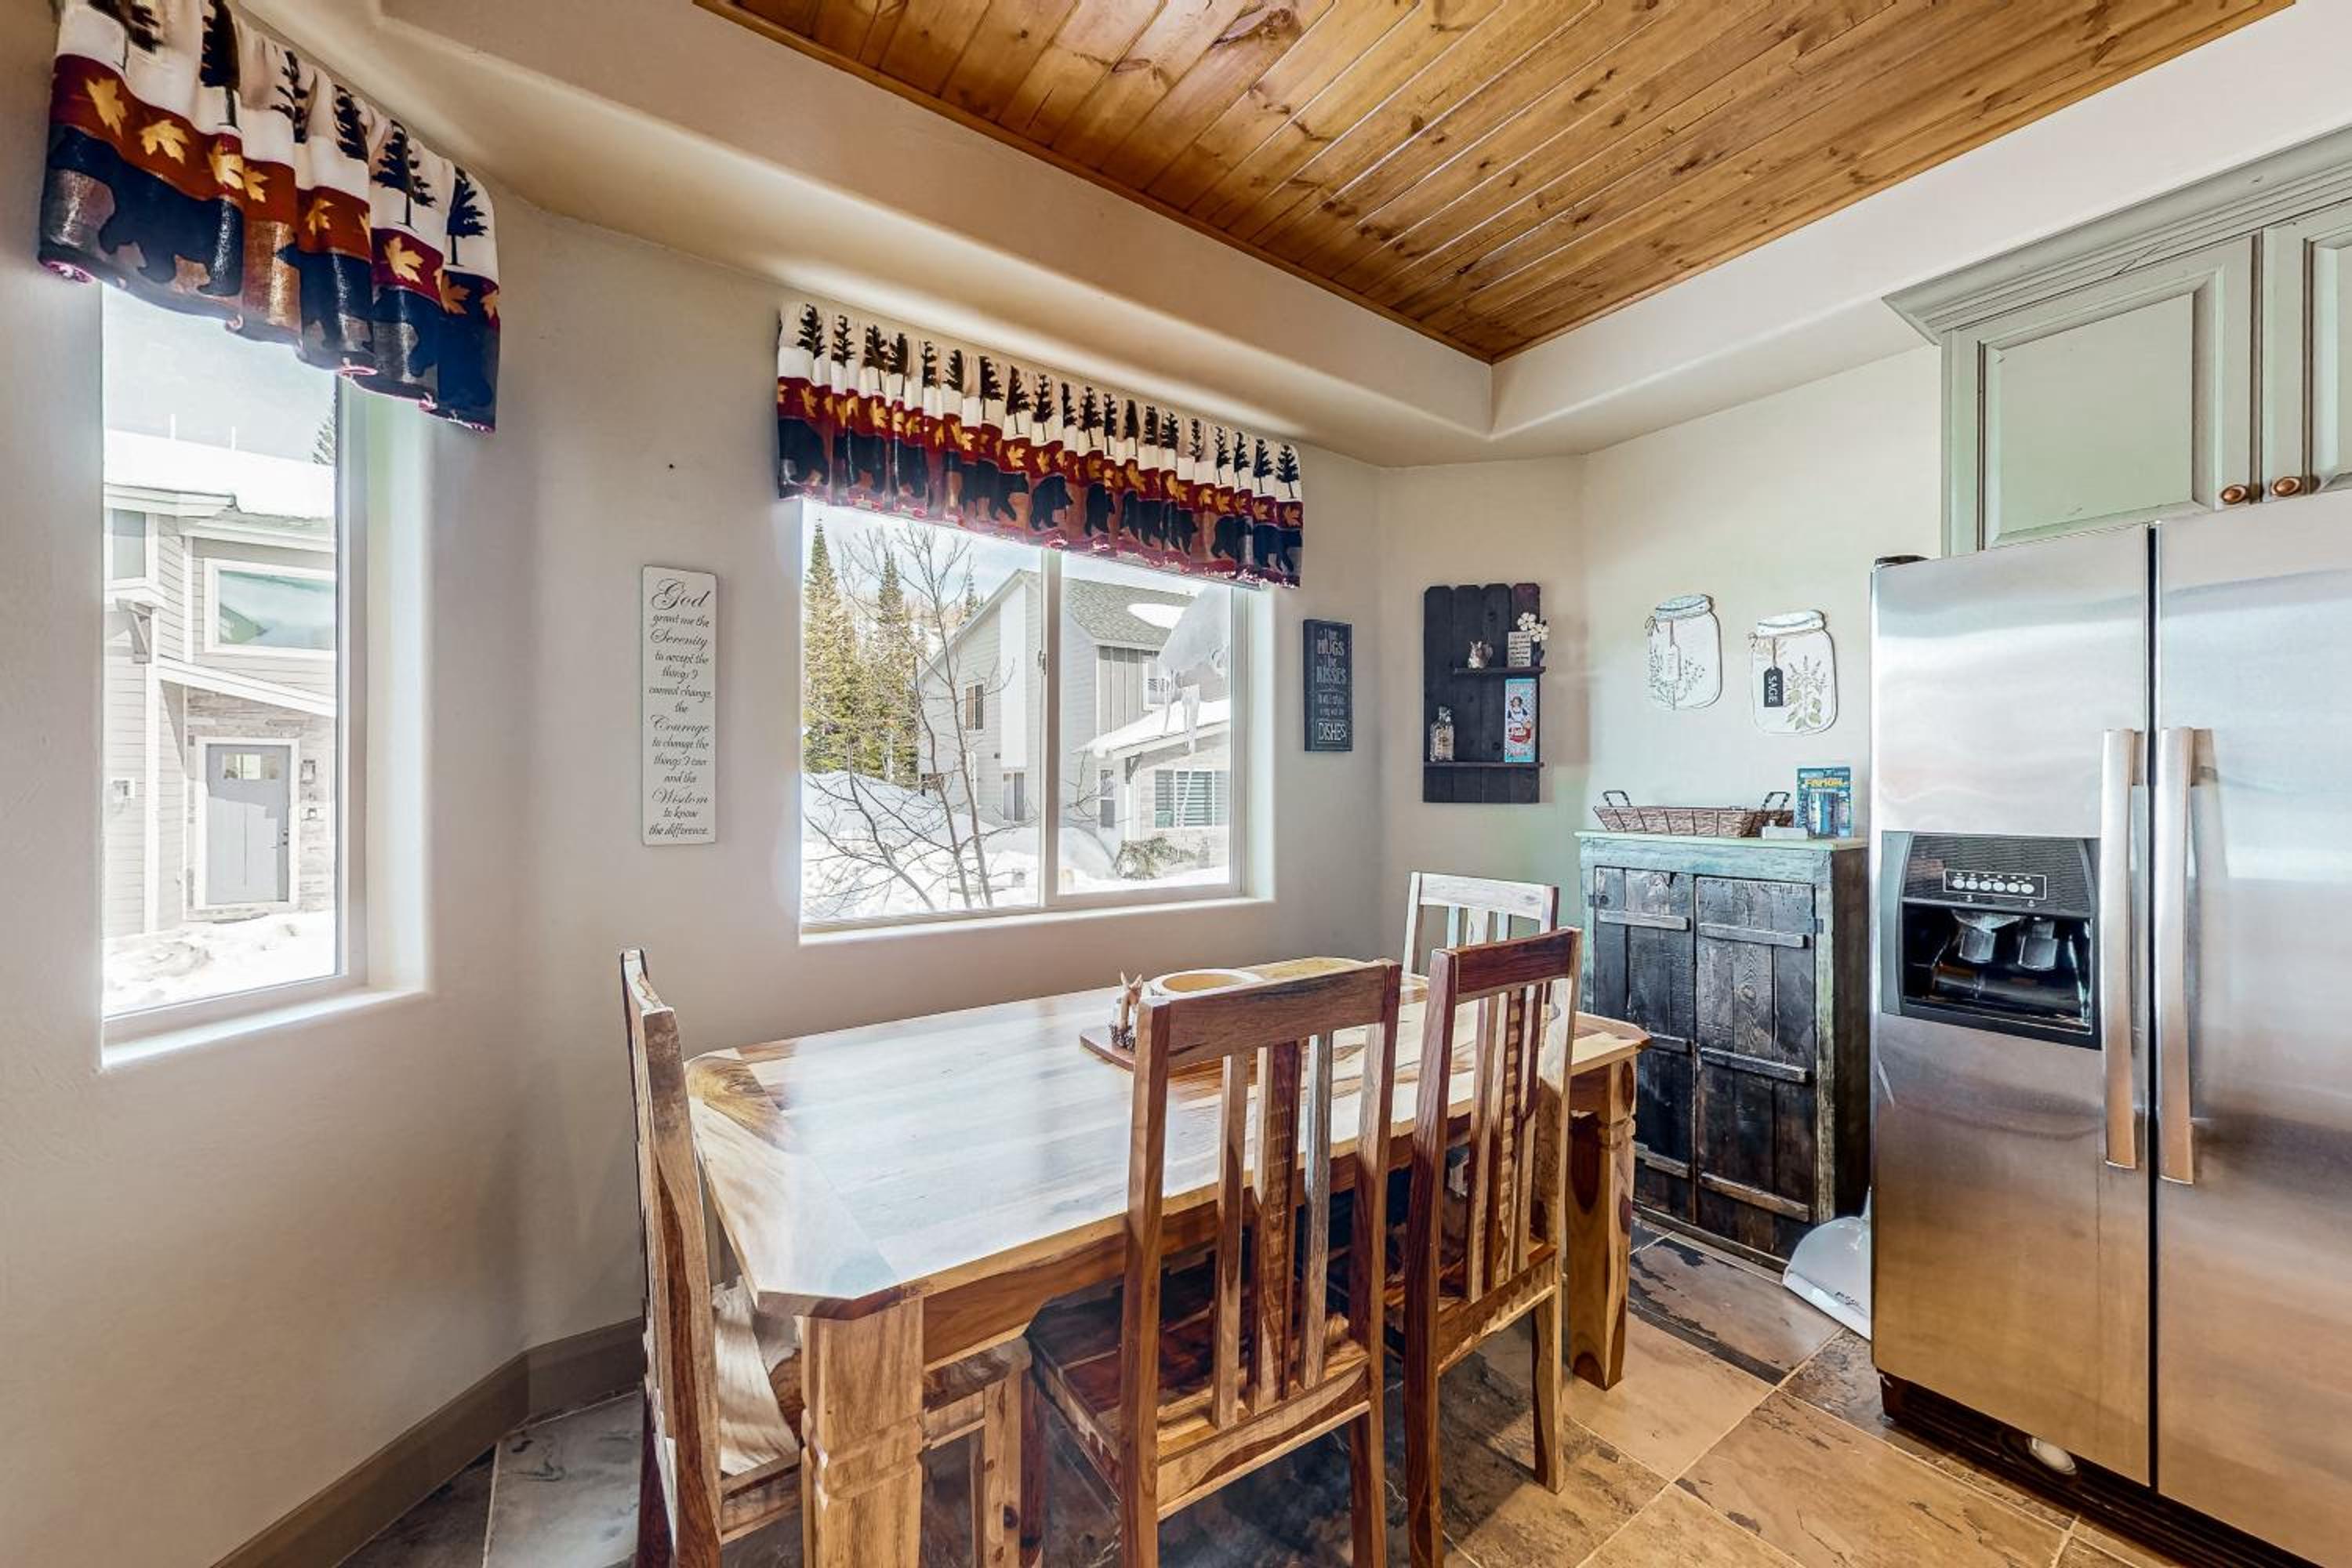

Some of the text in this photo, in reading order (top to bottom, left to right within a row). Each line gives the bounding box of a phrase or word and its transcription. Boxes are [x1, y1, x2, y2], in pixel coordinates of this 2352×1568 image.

[652, 578, 710, 610] God
[652, 614, 680, 627] grant
[695, 615, 710, 628] the
[650, 626, 708, 651] Serenity
[655, 652, 710, 668] to accept the
[662, 664, 690, 684] things
[1768, 675, 1778, 703] SAGE
[674, 699, 688, 713] the
[650, 714, 710, 738] Courage
[1318, 722, 1346, 741] DISHES
[652, 735, 710, 754] to change the
[653, 752, 681, 771] things
[664, 771, 696, 783] and the
[652, 787, 708, 804] Wisdom
[663, 805, 699, 819] to know
[648, 822, 664, 835] the
